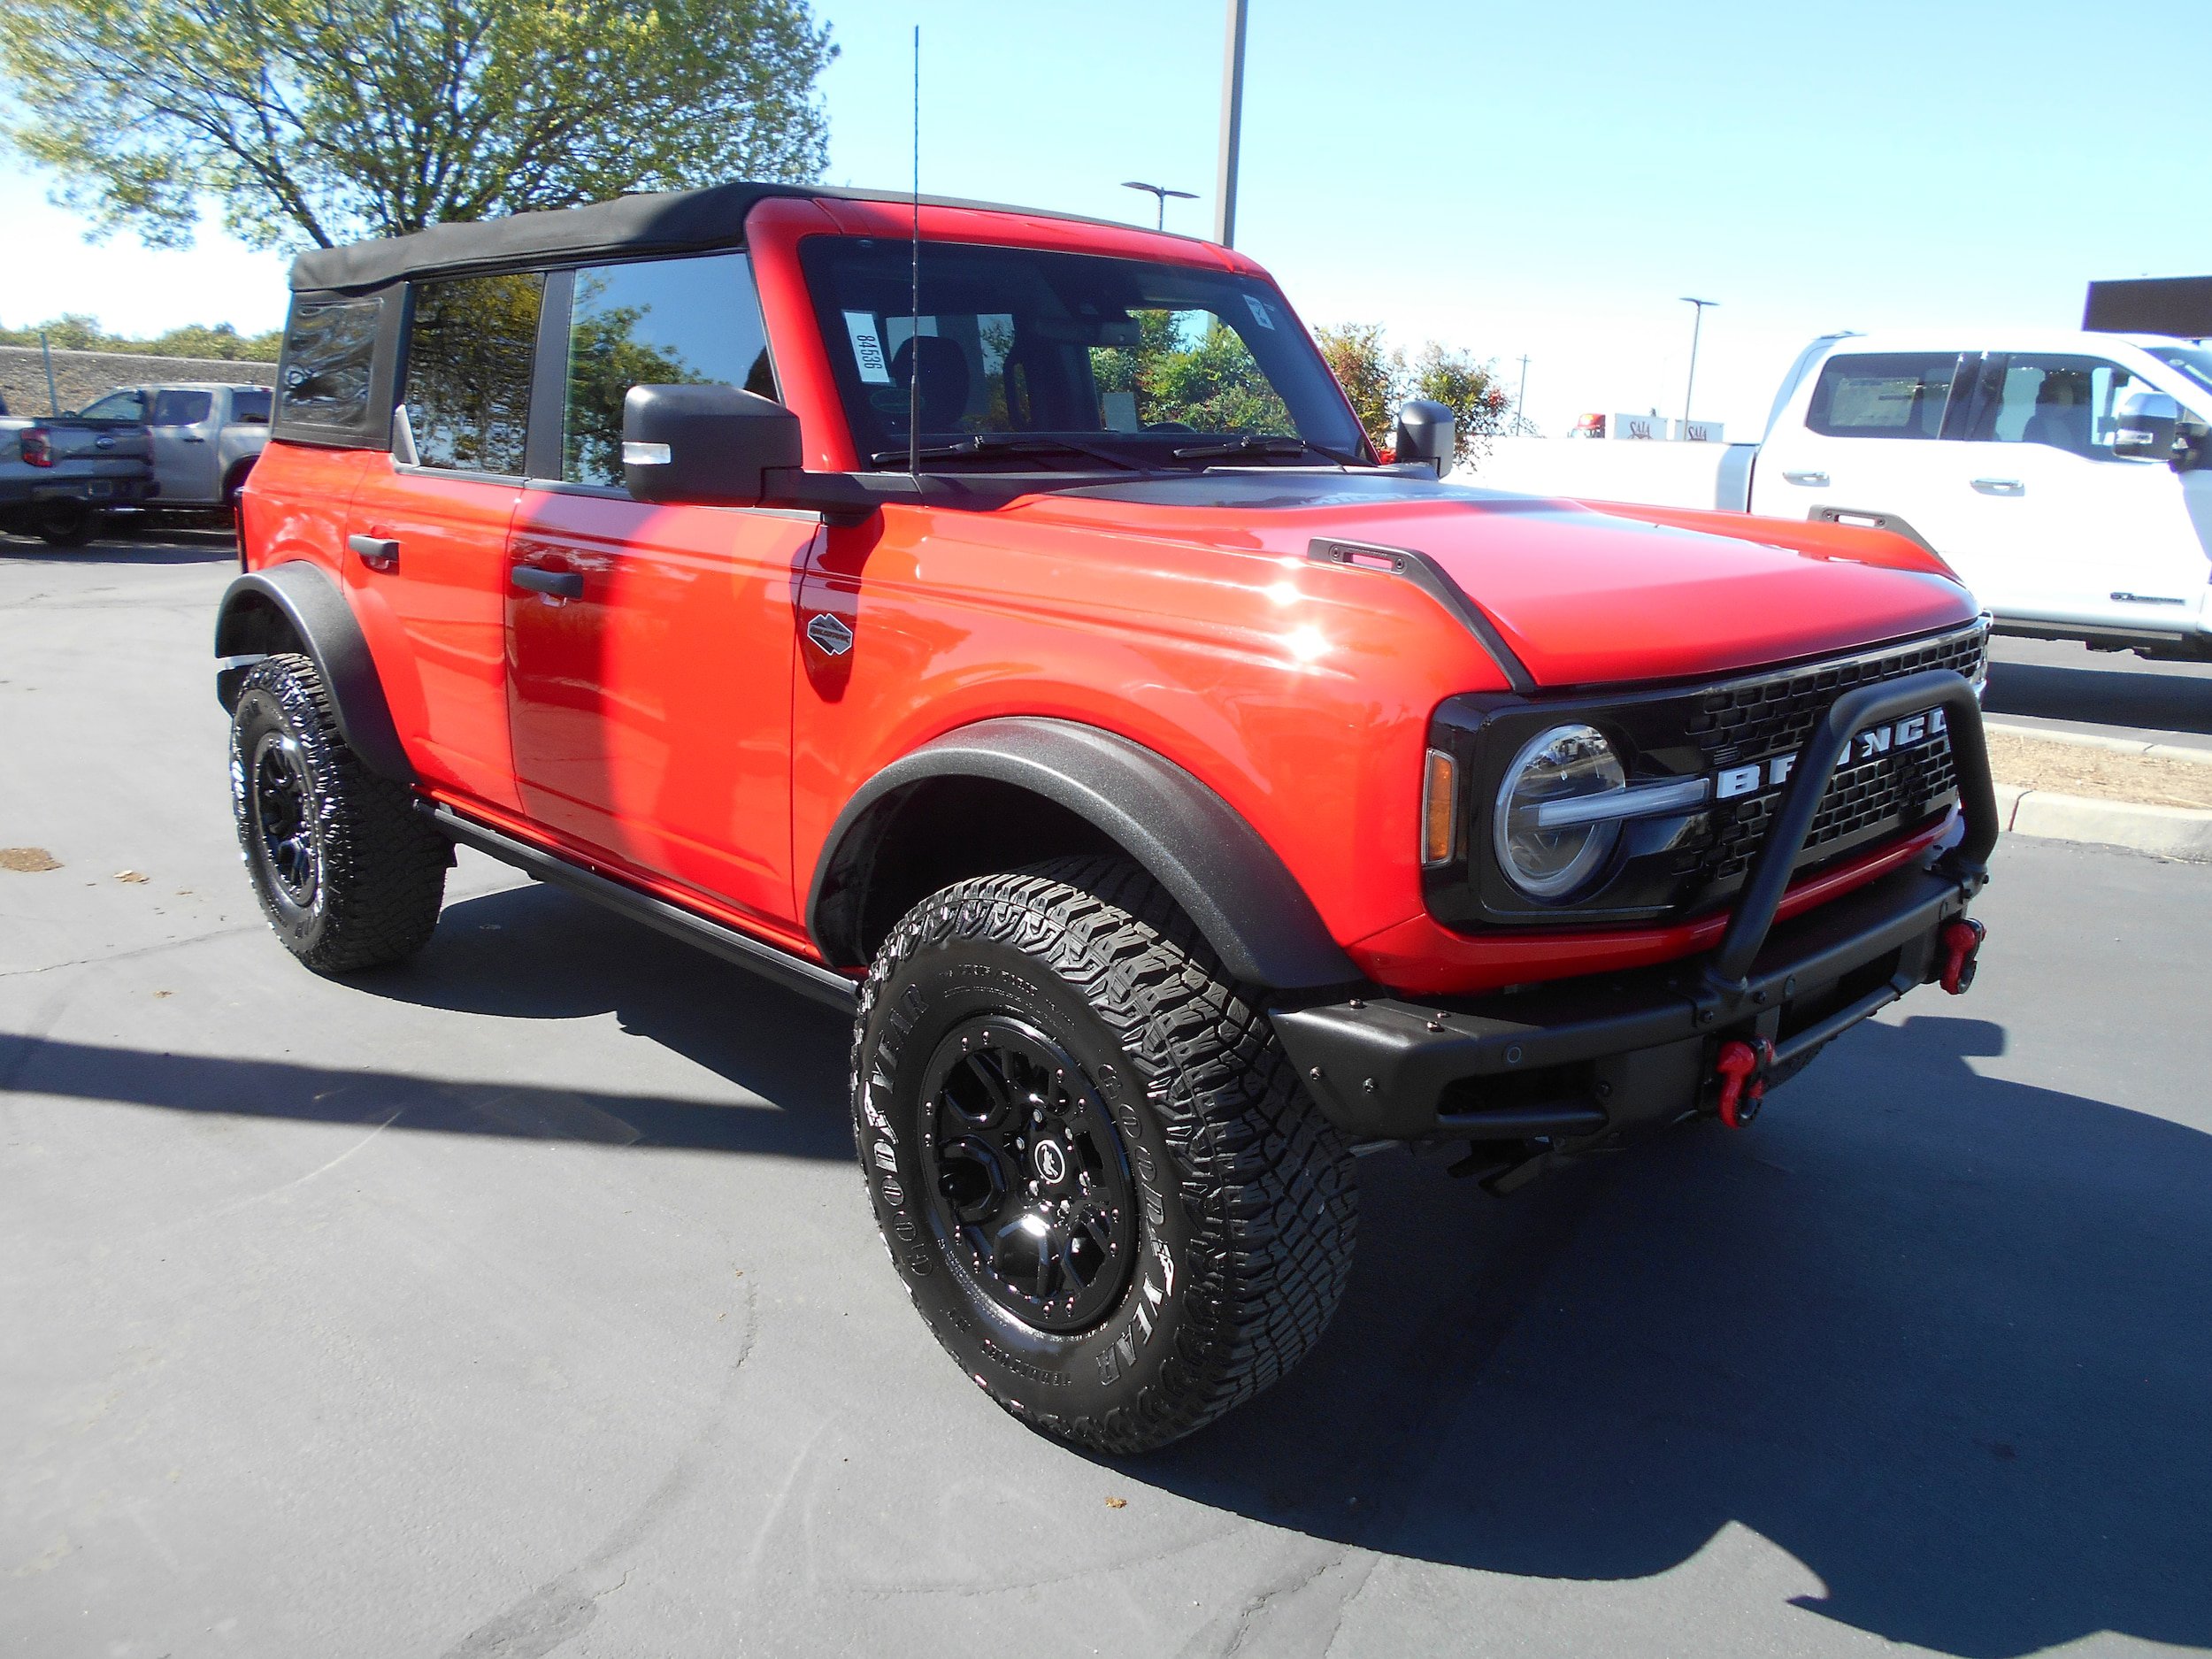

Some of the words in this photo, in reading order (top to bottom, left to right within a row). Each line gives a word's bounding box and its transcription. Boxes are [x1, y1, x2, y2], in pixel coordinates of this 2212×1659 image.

[856, 335, 882, 368] 84536
[864, 984, 931, 1276] GOODYEAR
[1096, 1063, 1174, 1386] GOODYEAR
